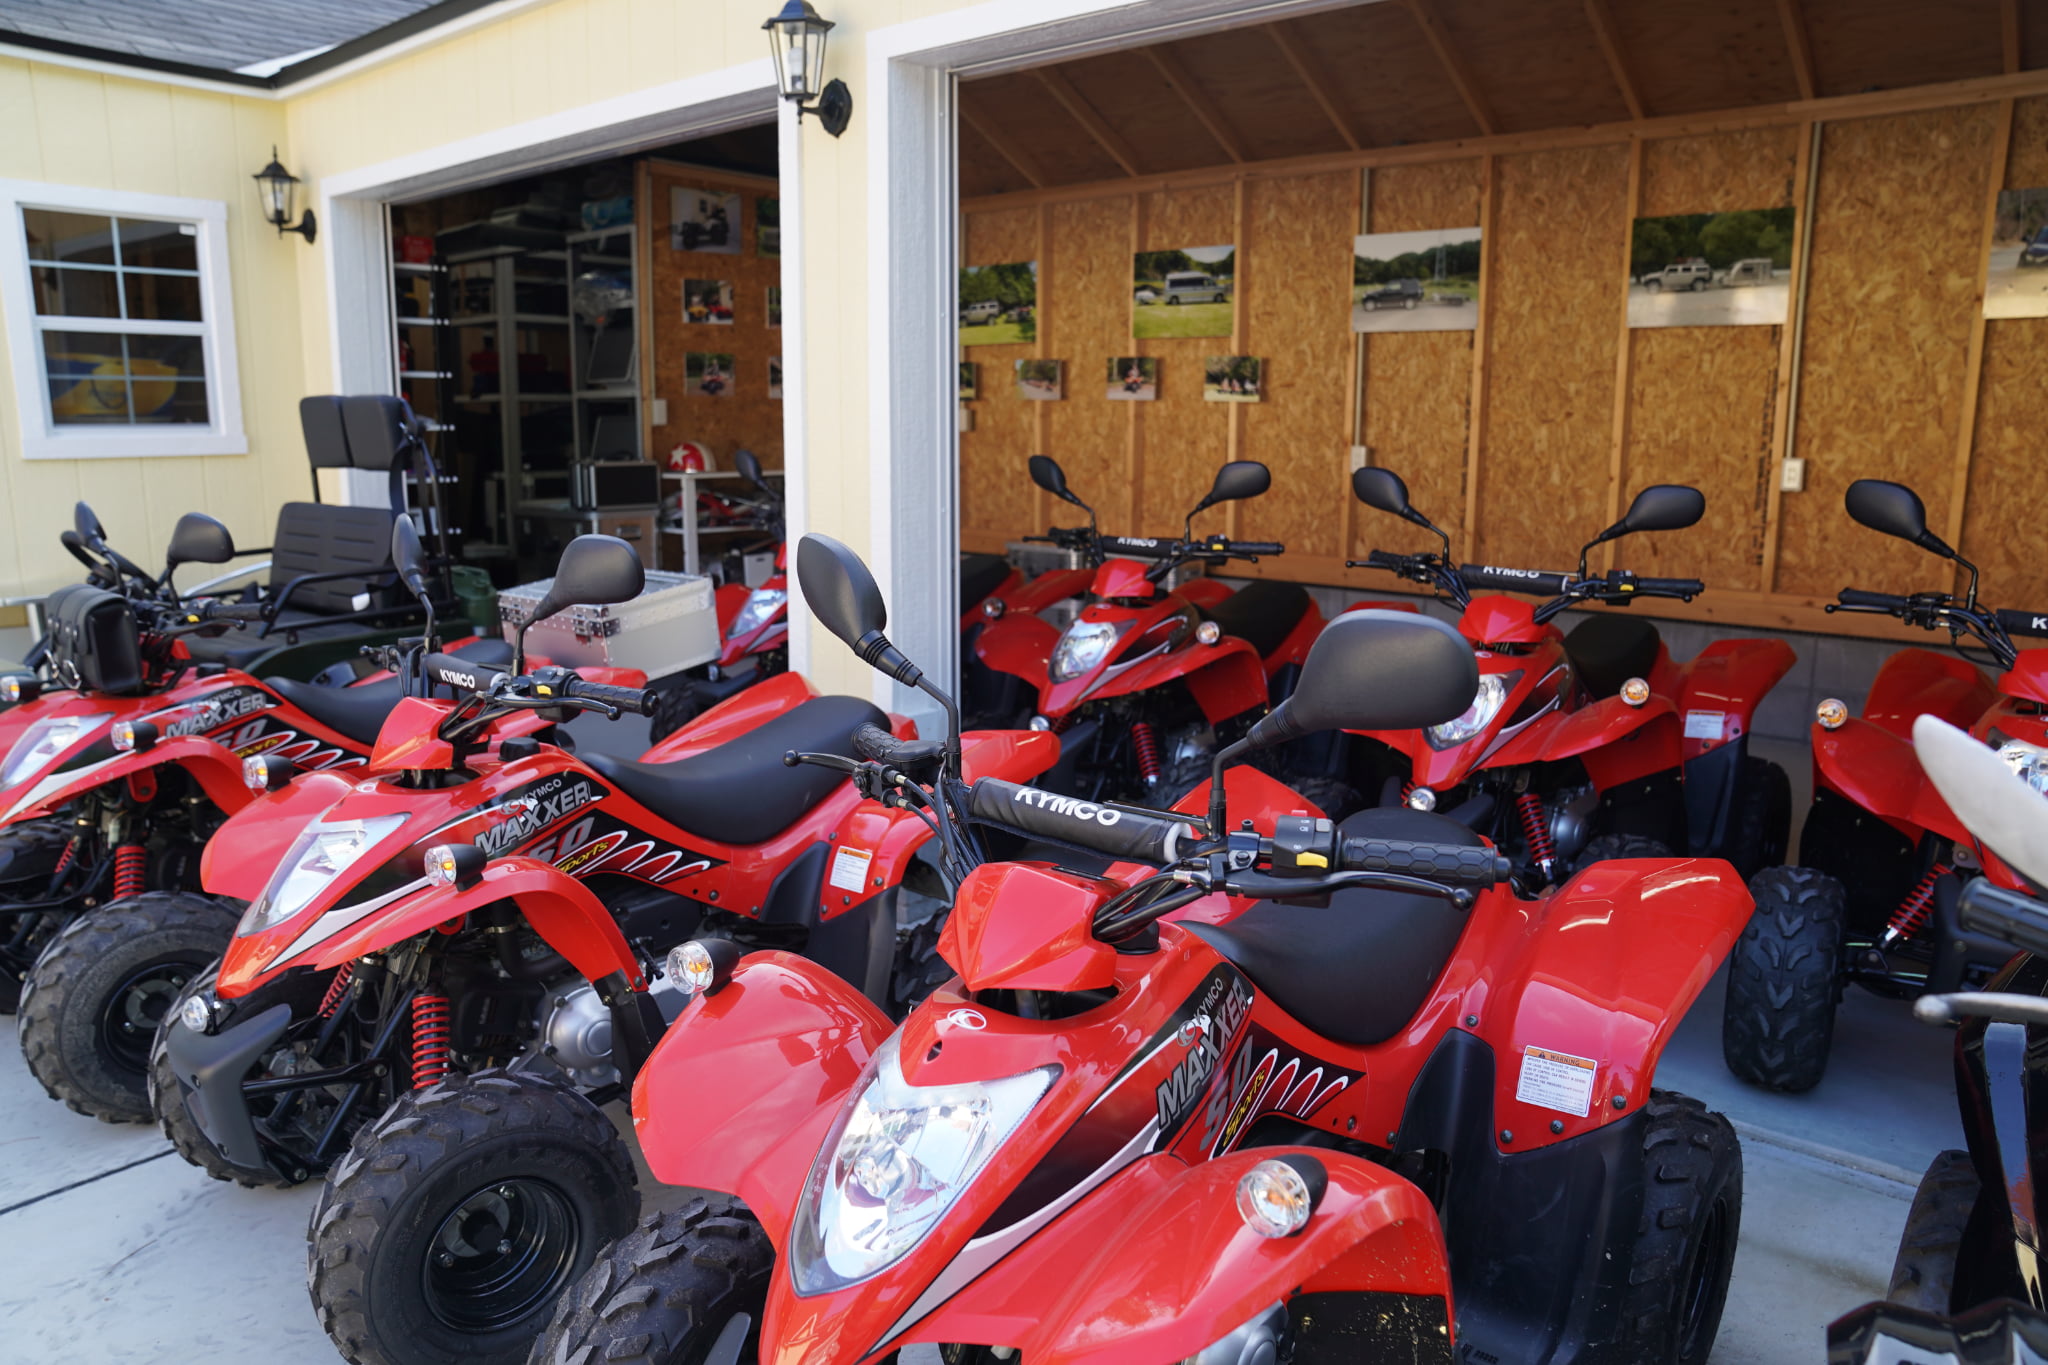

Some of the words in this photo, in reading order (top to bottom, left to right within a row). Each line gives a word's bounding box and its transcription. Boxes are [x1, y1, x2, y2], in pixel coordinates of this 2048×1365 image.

[1483, 565, 1540, 579] KYMCO
[439, 668, 476, 689] KYMCO
[166, 693, 267, 738] MAXXER
[521, 778, 562, 803] KYMCO
[1014, 787, 1122, 826] KYMCO
[474, 780, 592, 856] MAXXER
[1193, 976, 1224, 1021] KYMCO
[1156, 975, 1250, 1132] MAXXER
[1550, 1054, 1581, 1067] WARNING
